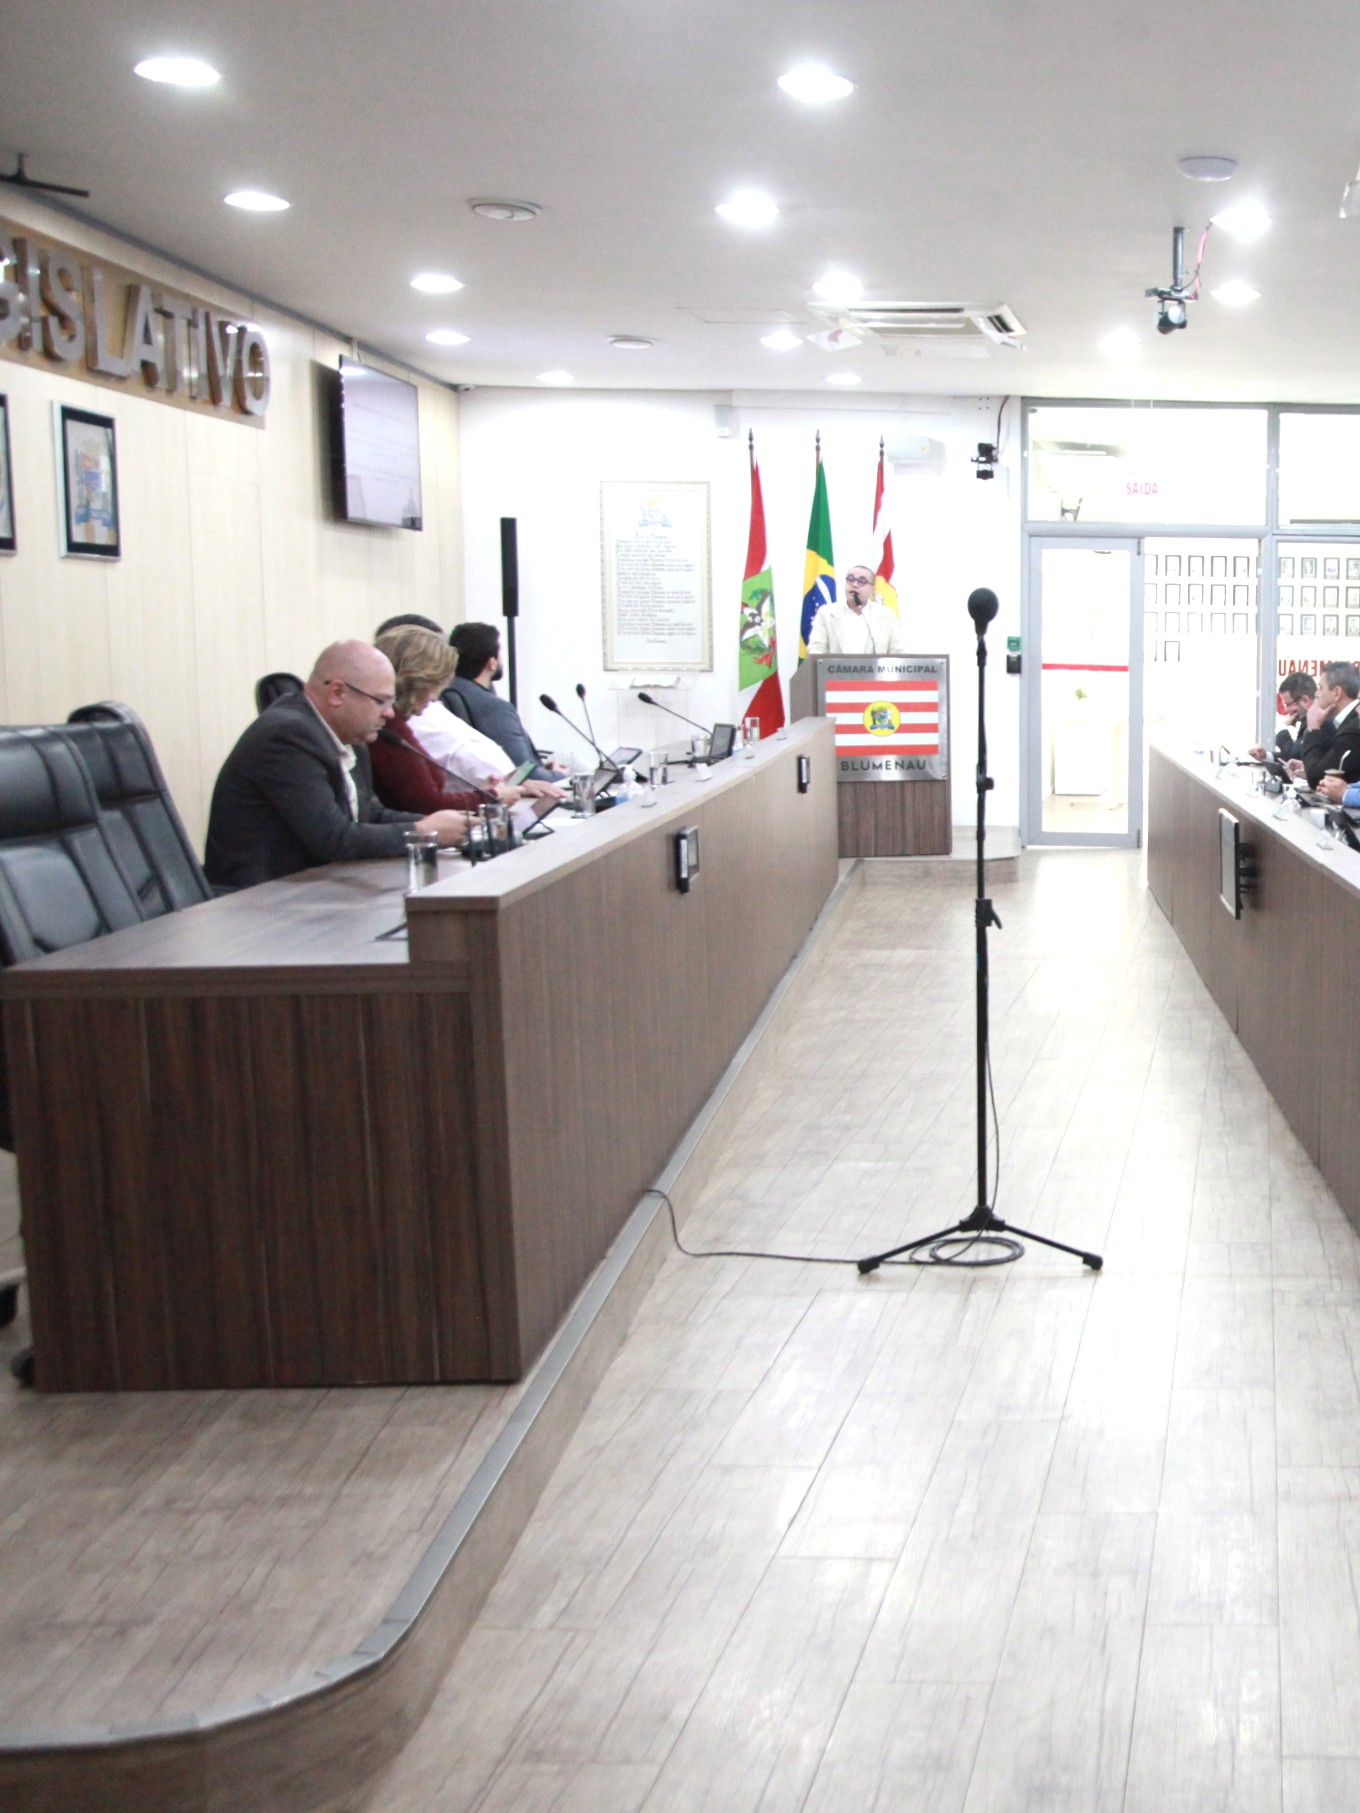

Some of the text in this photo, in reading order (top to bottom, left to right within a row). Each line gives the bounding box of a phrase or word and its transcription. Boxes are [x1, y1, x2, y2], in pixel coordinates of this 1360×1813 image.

[827, 663, 938, 674] CÂMARA MUNICIPAL
[841, 760, 926, 772] BLUMENAU
